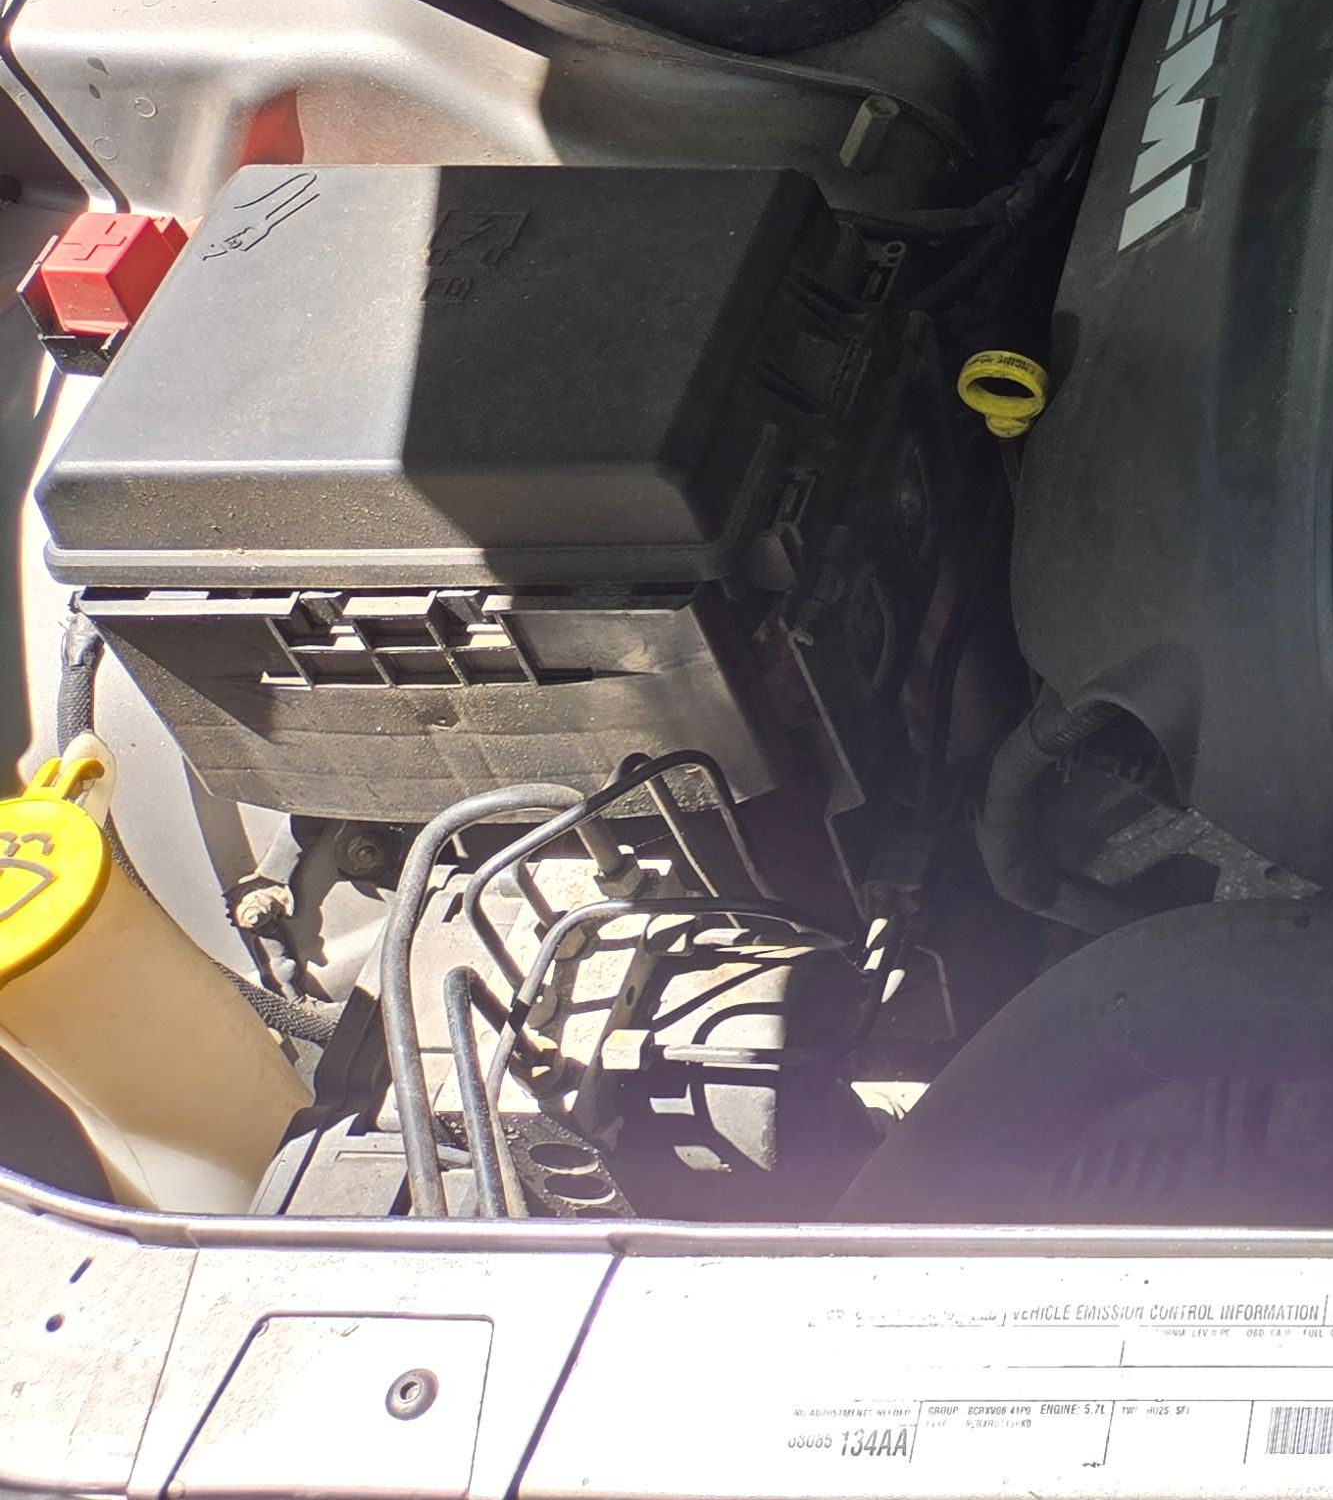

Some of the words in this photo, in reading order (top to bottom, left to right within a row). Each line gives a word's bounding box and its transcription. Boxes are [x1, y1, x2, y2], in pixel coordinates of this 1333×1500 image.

[1012, 1304, 1071, 1320] VEHICLE
[1075, 1304, 1144, 1320] EMISSION
[1149, 1304, 1214, 1320] CONTROL
[1219, 1304, 1320, 1321] INFORMATION
[1039, 1404, 1080, 1415] ENGINE:
[1083, 1404, 1106, 1415] 5.7L
[841, 1428, 907, 1456] 134AA
